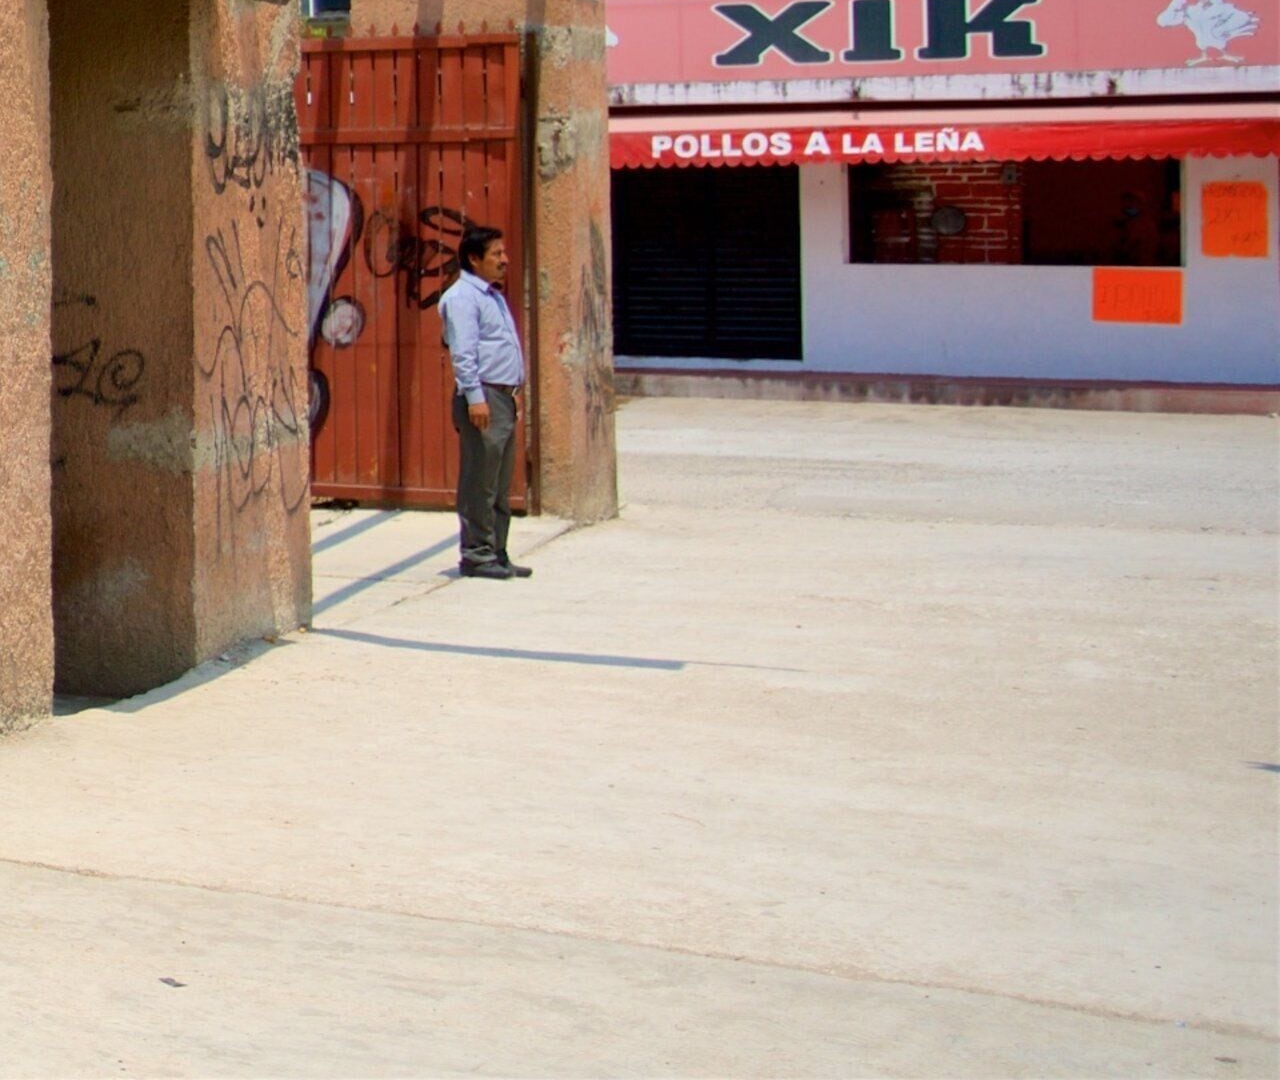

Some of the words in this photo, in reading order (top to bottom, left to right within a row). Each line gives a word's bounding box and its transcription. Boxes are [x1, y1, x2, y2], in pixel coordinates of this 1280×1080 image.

[651, 131, 793, 160] POLLOS
[803, 130, 831, 156] A
[842, 131, 884, 156] LA
[894, 126, 985, 155] LEÑA
